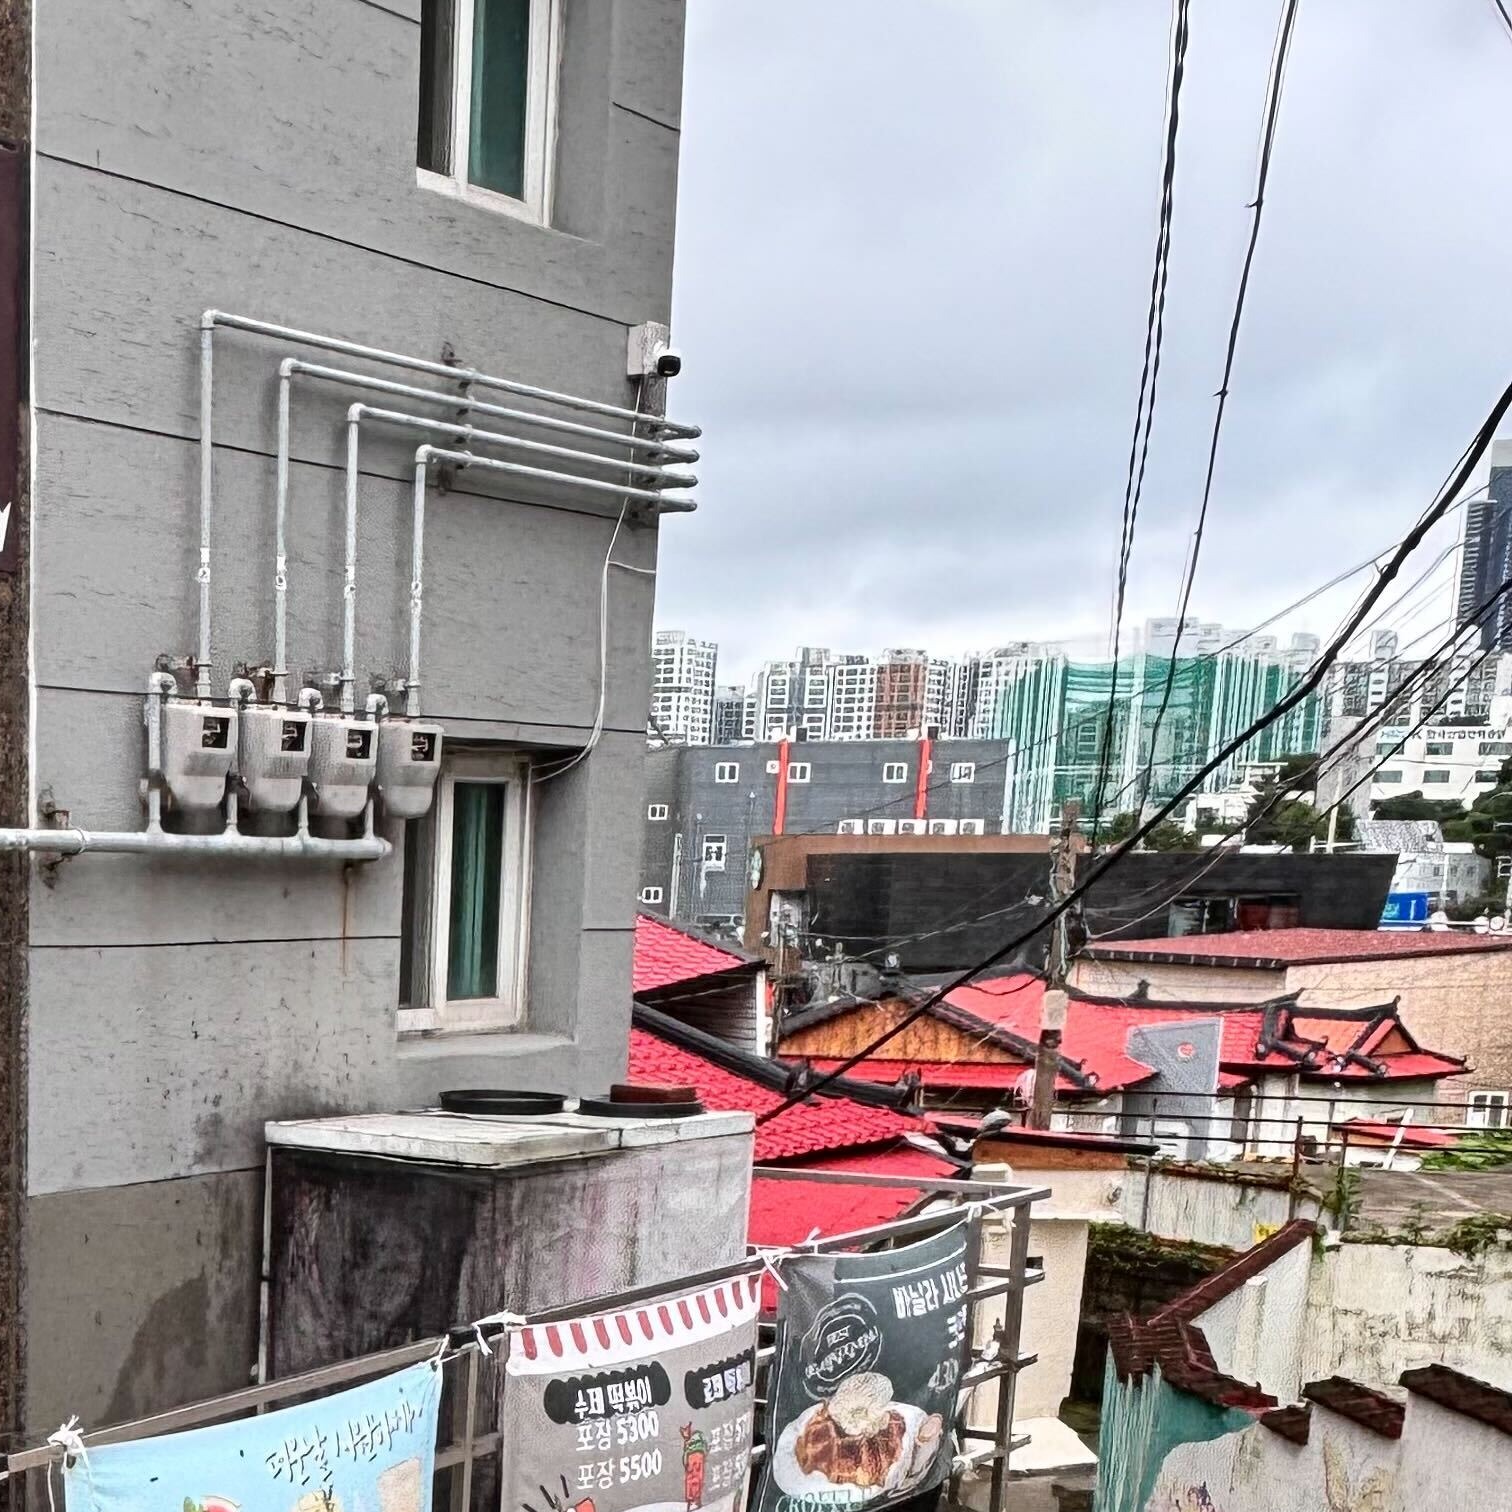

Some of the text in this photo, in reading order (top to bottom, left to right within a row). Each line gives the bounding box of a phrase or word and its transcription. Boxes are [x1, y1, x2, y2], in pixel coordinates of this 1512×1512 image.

[606, 1375, 653, 1413] 떡볶이
[575, 1419, 612, 1451] 포장
[576, 1458, 616, 1490] 포장
[619, 1447, 663, 1484] 5500
